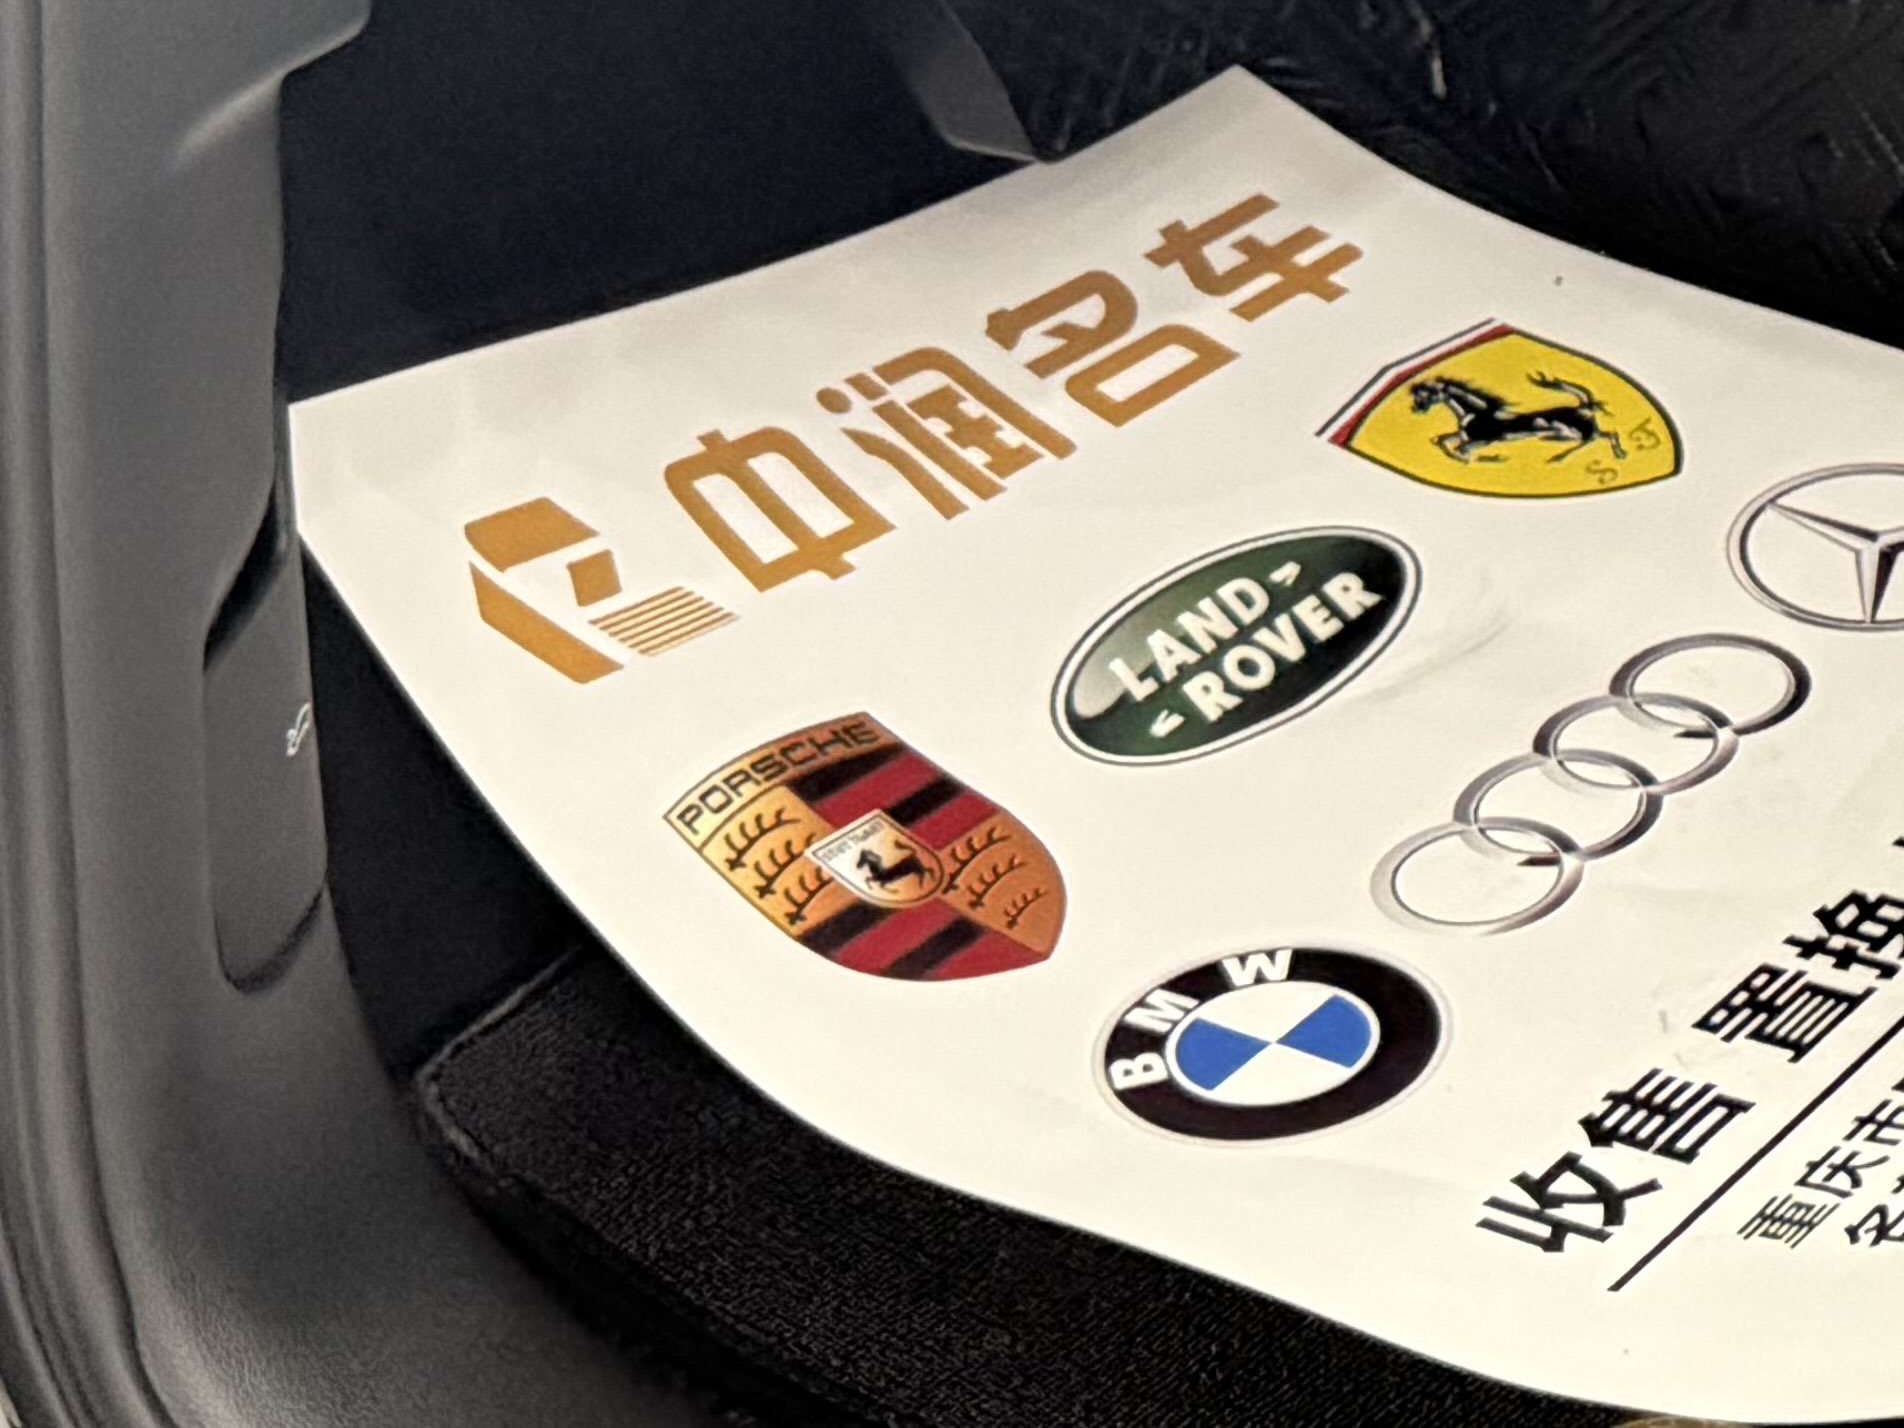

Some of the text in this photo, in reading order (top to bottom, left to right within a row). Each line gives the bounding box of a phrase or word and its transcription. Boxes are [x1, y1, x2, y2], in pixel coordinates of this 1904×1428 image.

[664, 193, 1362, 584] 中润名车
[1107, 574, 1268, 702] LAND
[1182, 571, 1384, 727] ROVER
[677, 722, 880, 835] PORSCHE
[1109, 948, 1292, 1091] BMW
[1475, 1068, 1756, 1252] 收售
